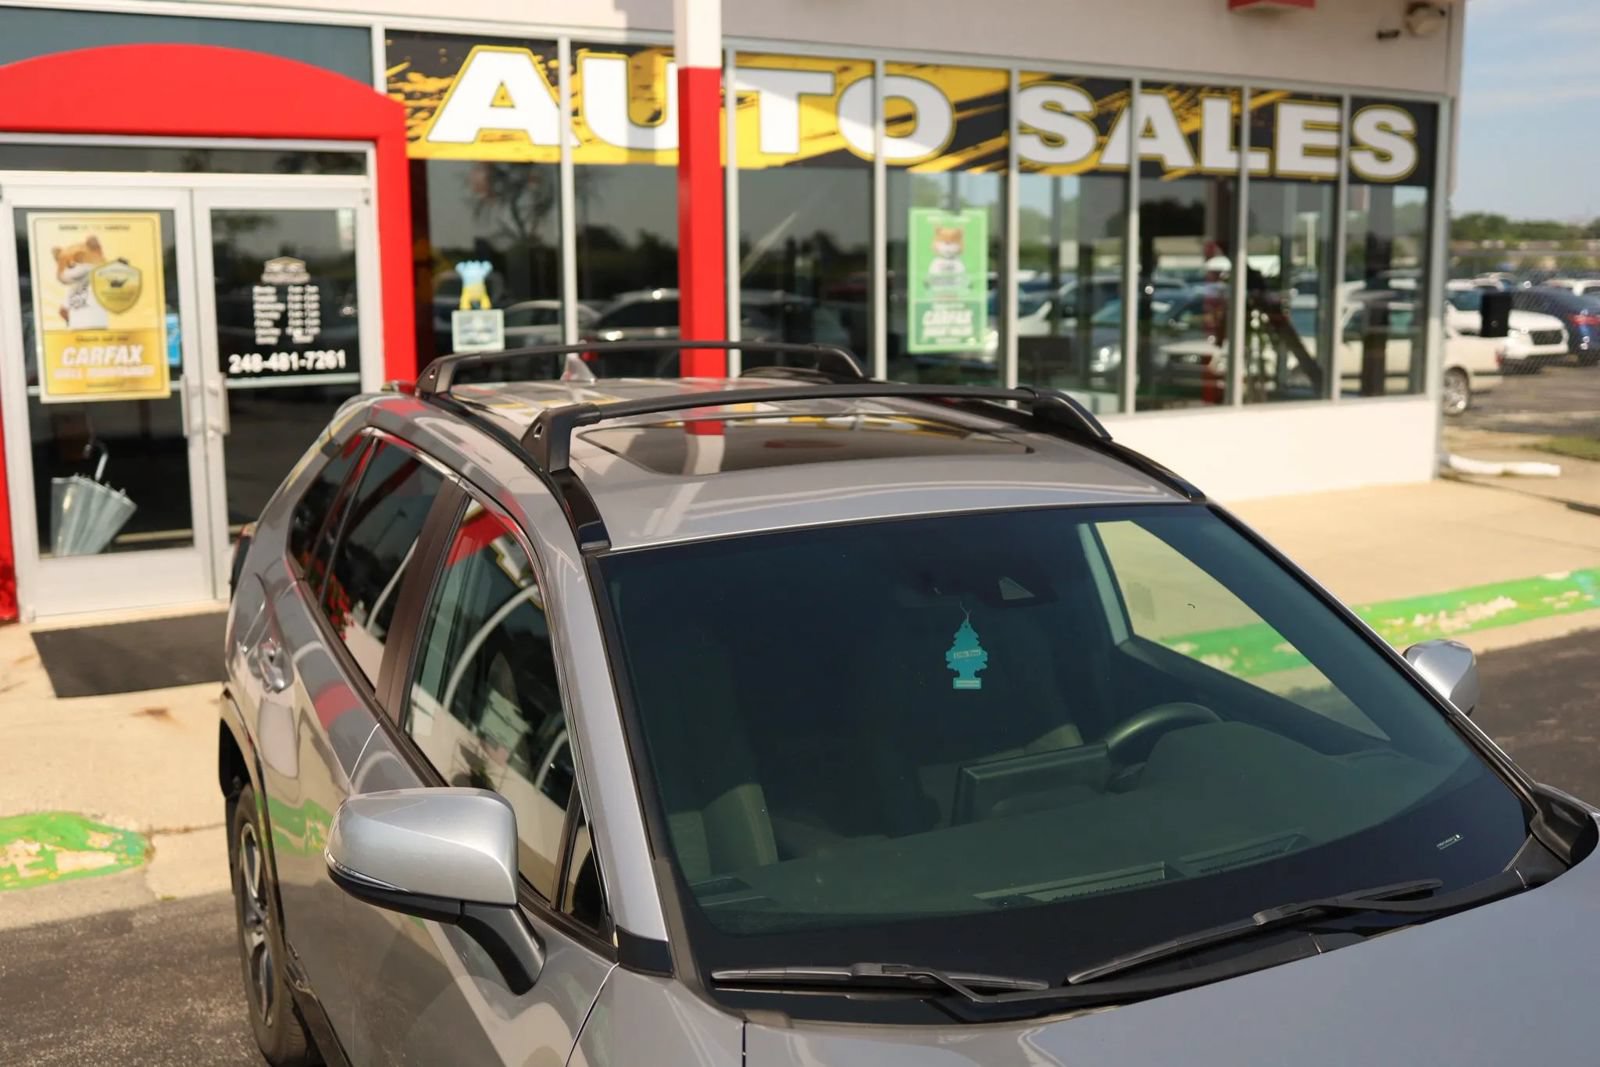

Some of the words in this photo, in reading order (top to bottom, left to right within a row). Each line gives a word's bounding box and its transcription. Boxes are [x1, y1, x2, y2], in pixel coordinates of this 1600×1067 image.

[427, 46, 956, 163] AUTO
[1015, 83, 1418, 181] SALES
[61, 344, 145, 366] CARFAX
